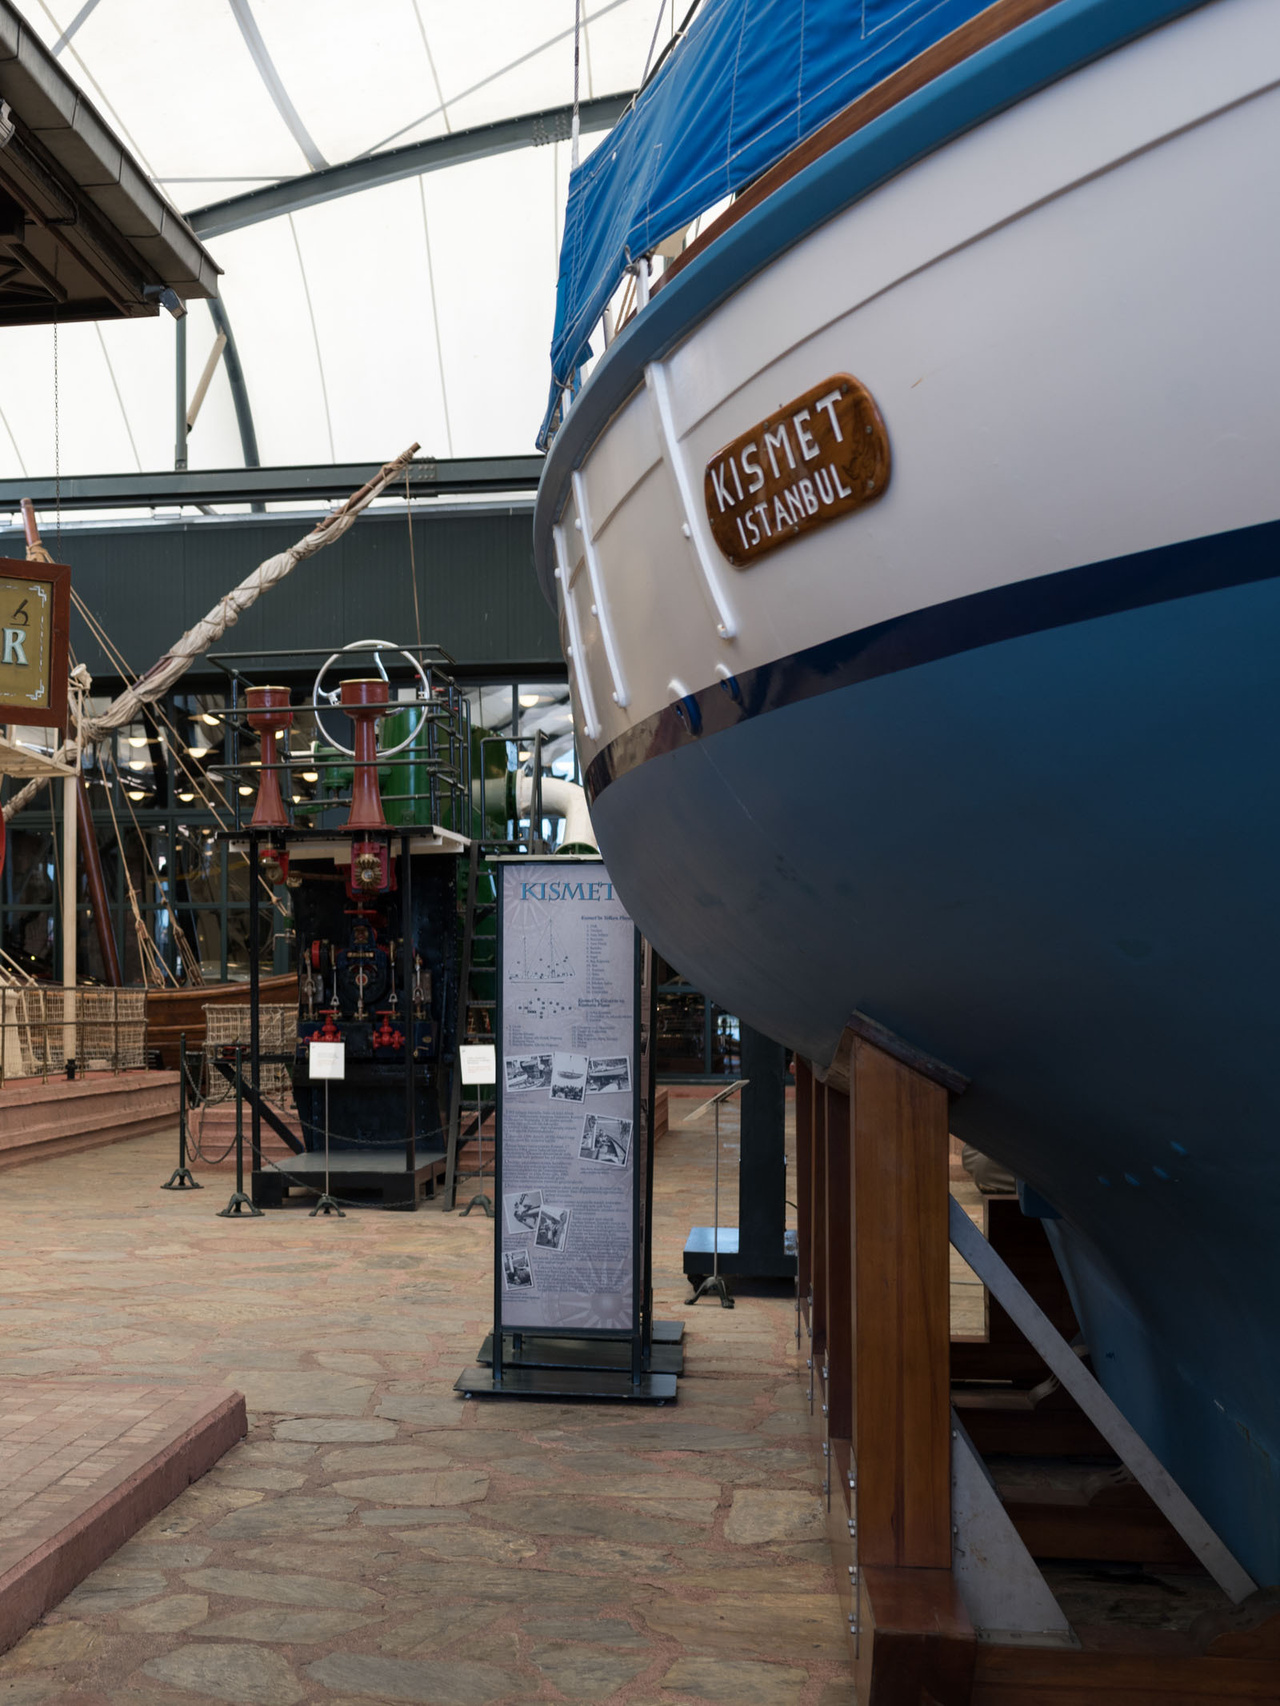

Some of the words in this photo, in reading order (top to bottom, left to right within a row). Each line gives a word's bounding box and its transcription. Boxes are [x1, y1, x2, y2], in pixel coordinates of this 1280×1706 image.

[711, 389, 844, 513] KISMET
[736, 463, 852, 550] ISTANBUL
[520, 881, 615, 902] KISMET
